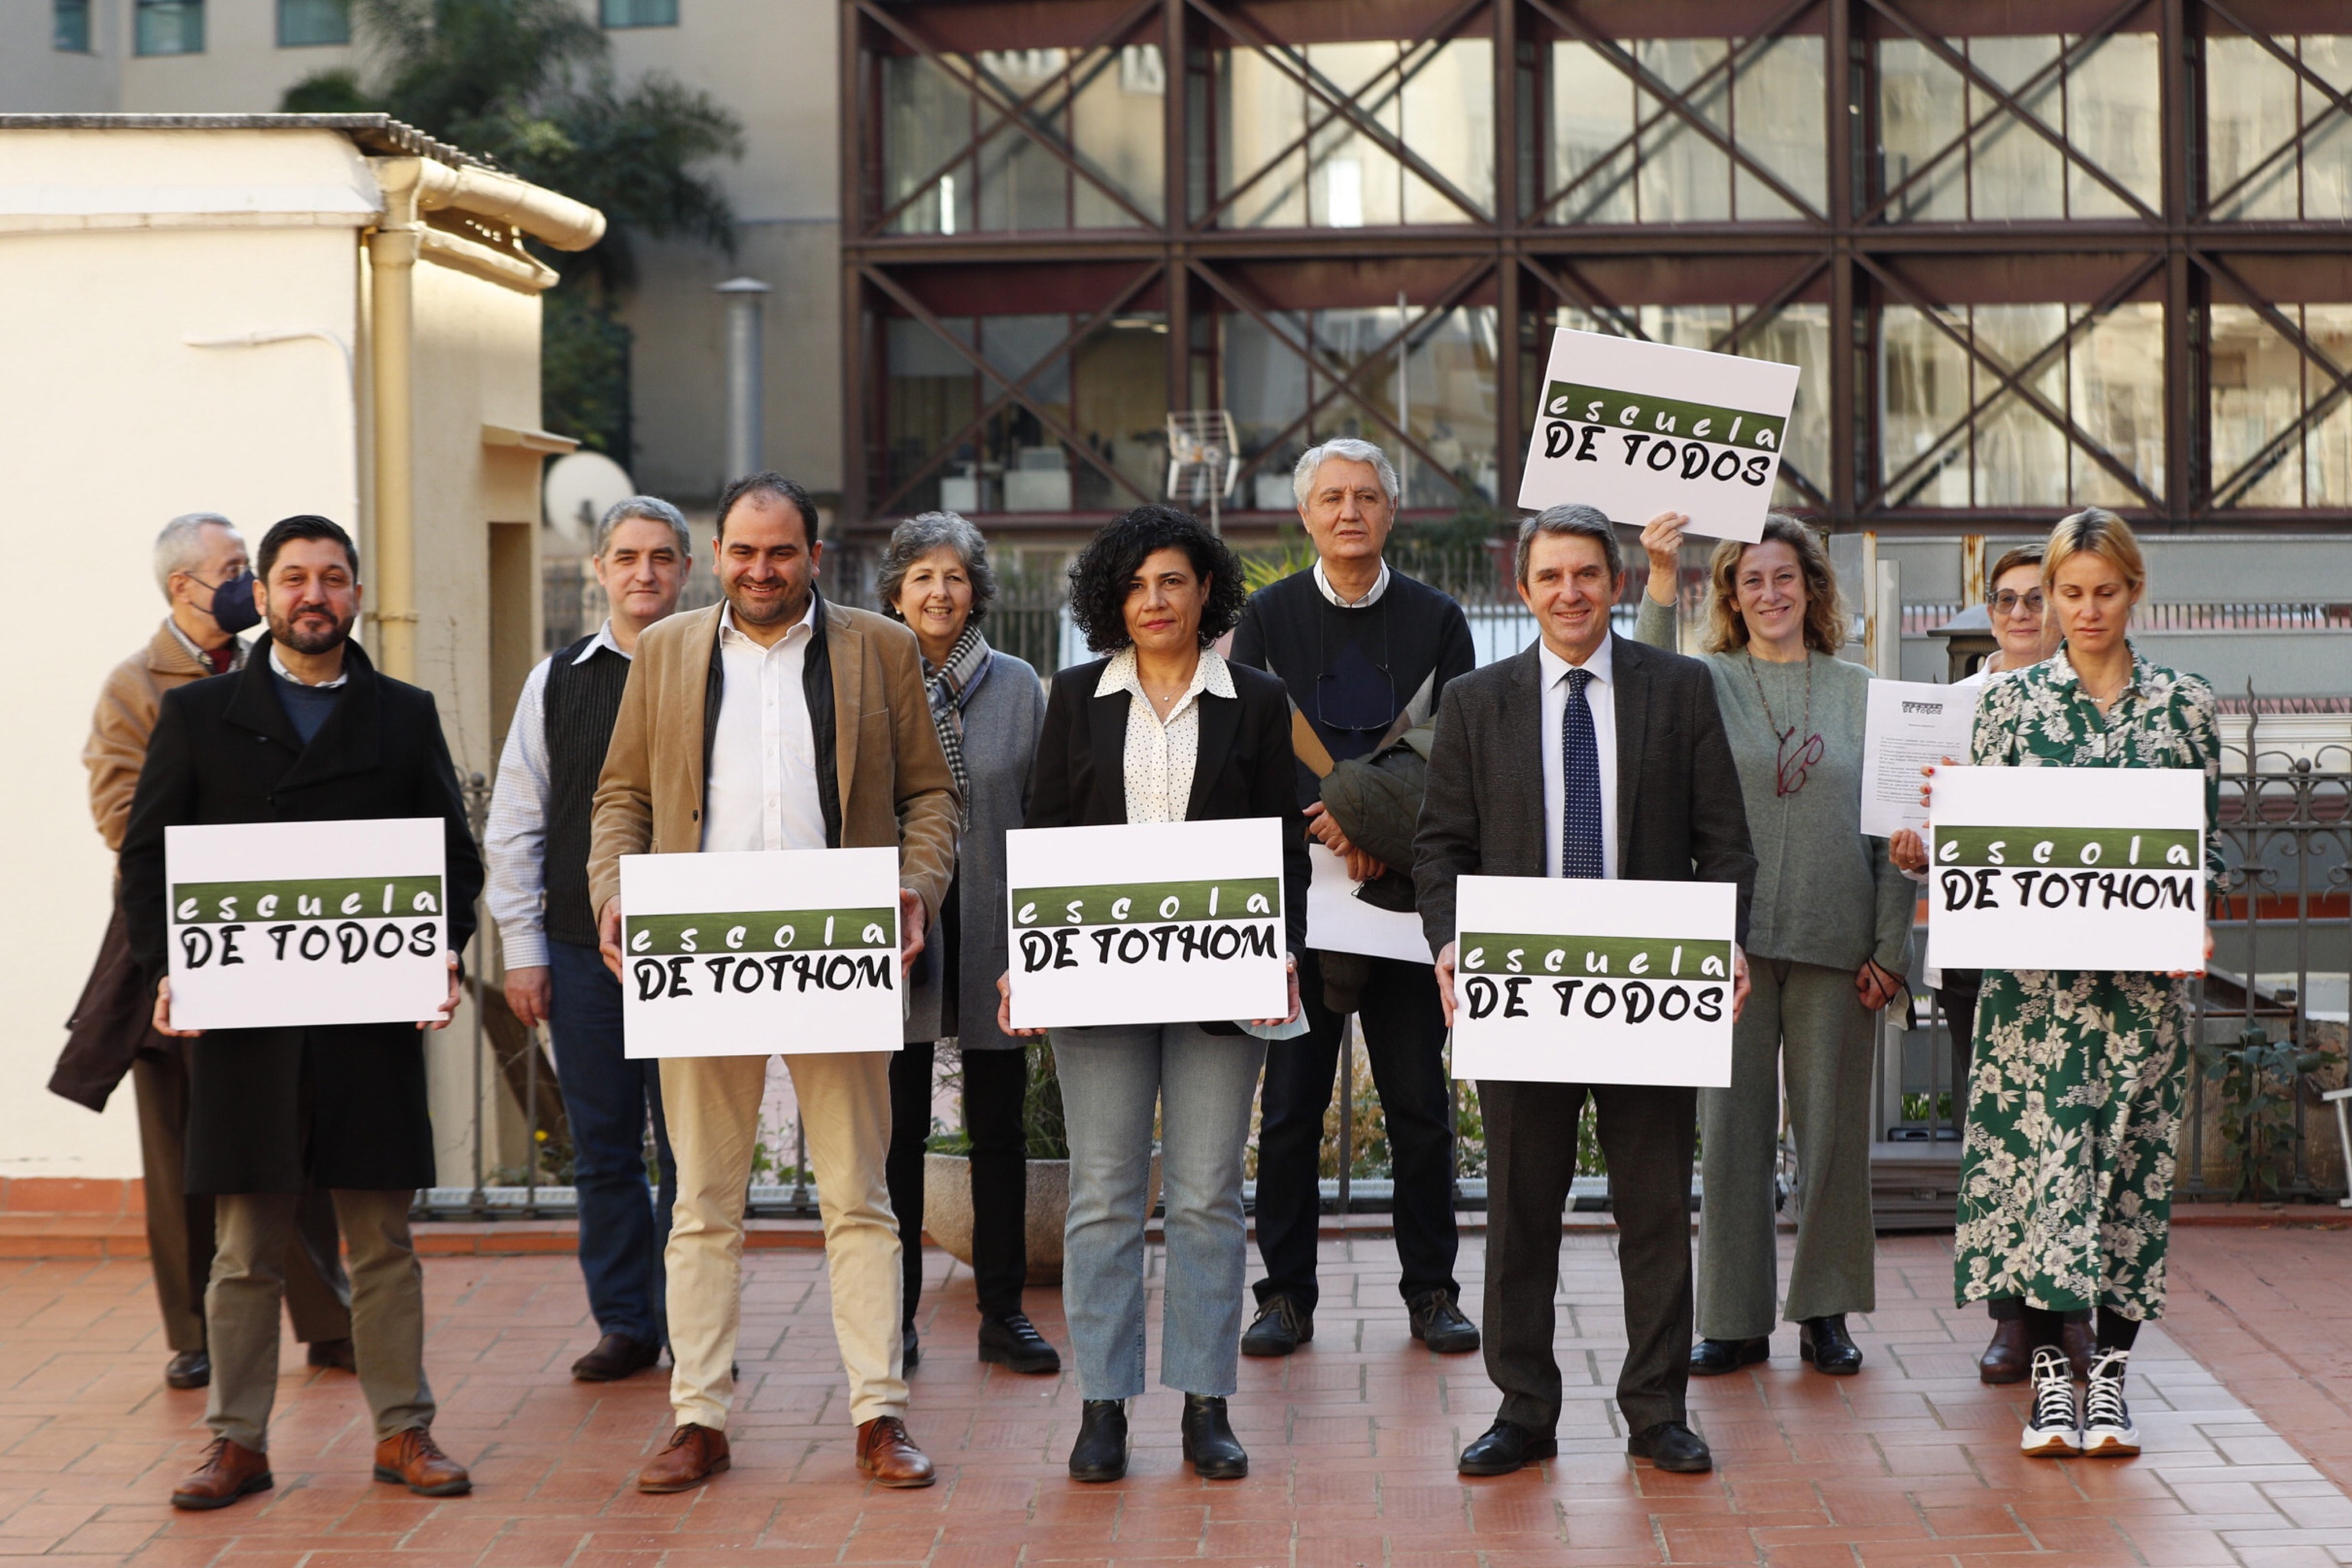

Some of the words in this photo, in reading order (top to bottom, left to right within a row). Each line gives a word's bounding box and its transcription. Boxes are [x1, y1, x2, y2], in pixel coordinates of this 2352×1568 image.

[1549, 395, 1775, 449] escuela
[1544, 420, 1606, 462] DE
[1622, 434, 1771, 486] TODOS
[1939, 835, 2191, 865] escola
[177, 883, 438, 920] escuela
[1018, 886, 1270, 924] escola
[1941, 868, 2001, 912] DE
[2011, 871, 2196, 911] TOTHOM
[181, 924, 246, 969] DE
[267, 921, 436, 964] TODOS
[631, 915, 886, 952] escola
[1019, 928, 1080, 973] DE
[1090, 923, 1278, 964] TOTHOM
[633, 956, 694, 1001] DE
[705, 954, 893, 993] TOTHOM
[1465, 945, 1725, 978] escuela
[1465, 976, 1532, 1020] DE
[1552, 980, 1724, 1024] TODOS
